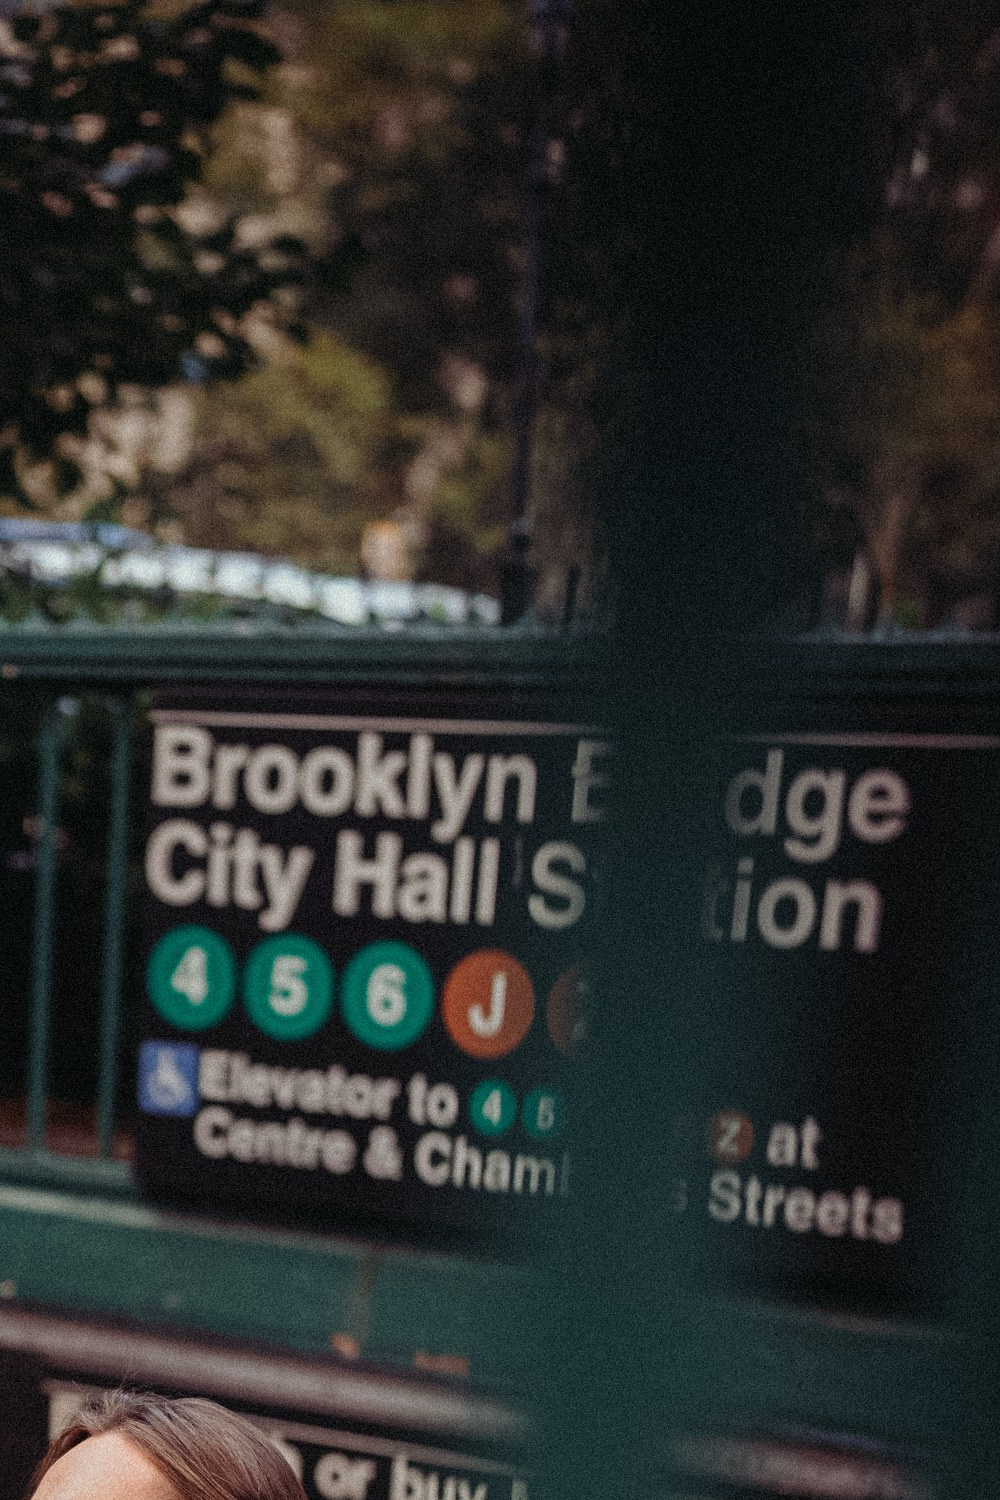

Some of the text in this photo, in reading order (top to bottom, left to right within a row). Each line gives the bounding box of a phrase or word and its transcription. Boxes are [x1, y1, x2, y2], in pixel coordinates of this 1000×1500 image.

[150, 725, 912, 864] Brooklyn Bdge
[145, 818, 316, 932] City
[332, 829, 499, 926] Hall
[171, 946, 209, 1006] 4
[267, 954, 310, 1017] 5
[365, 963, 408, 1028] 6
[467, 970, 507, 1038] J
[199, 1049, 400, 1121] Elevator
[408, 1073, 460, 1128] to
[766, 1115, 822, 1171] at
[193, 1105, 358, 1176] Centre
[364, 1124, 402, 1182] &
[708, 1170, 905, 1245] Streets
